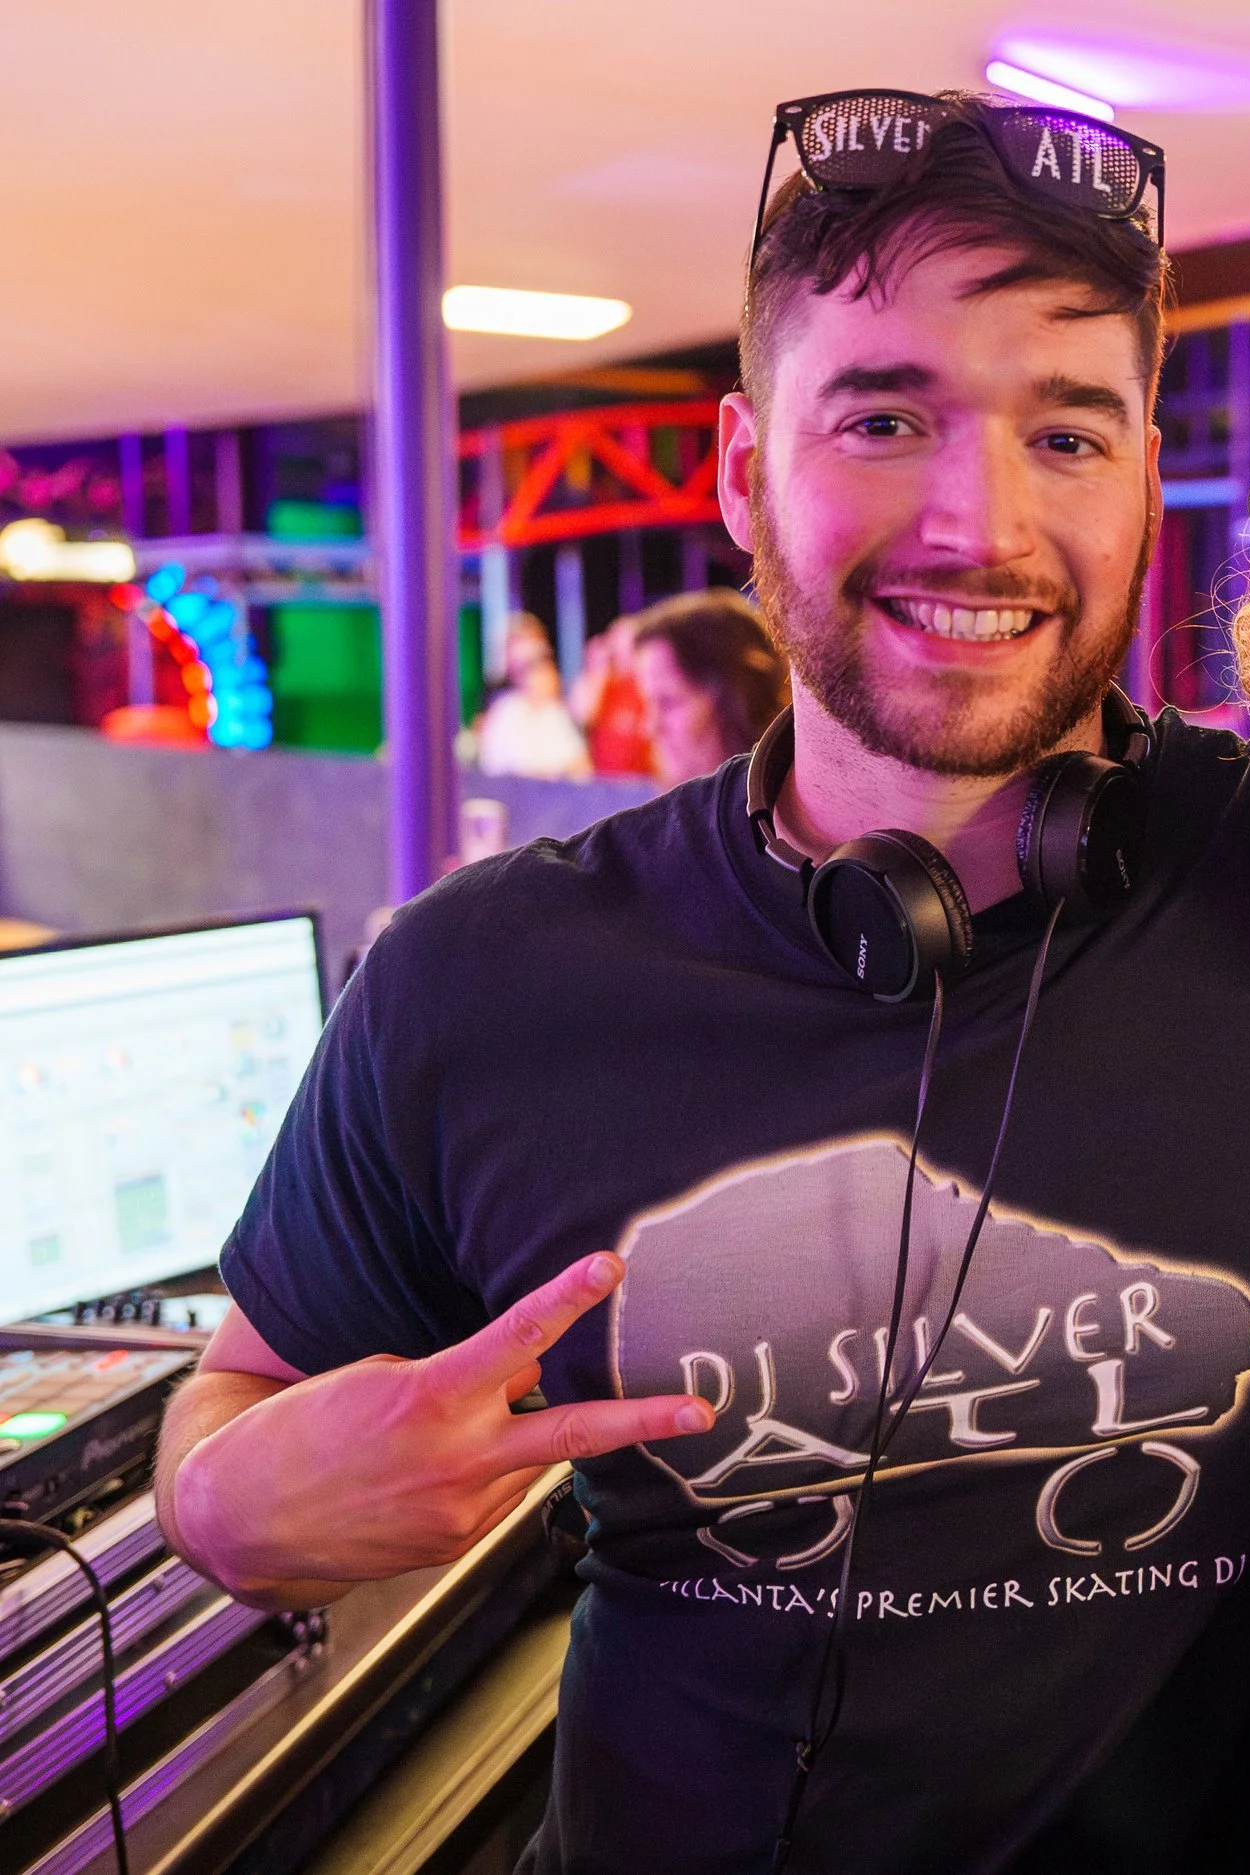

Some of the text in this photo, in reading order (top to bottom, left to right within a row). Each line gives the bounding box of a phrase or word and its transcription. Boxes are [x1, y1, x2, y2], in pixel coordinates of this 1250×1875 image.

[1031, 127, 1112, 193] ATL
[857, 933, 868, 979] SONY
[679, 1281, 1176, 1424] DJ SILVER
[857, 1580, 1034, 1620] PREMIER
[1048, 1560, 1199, 1606] SKATING
